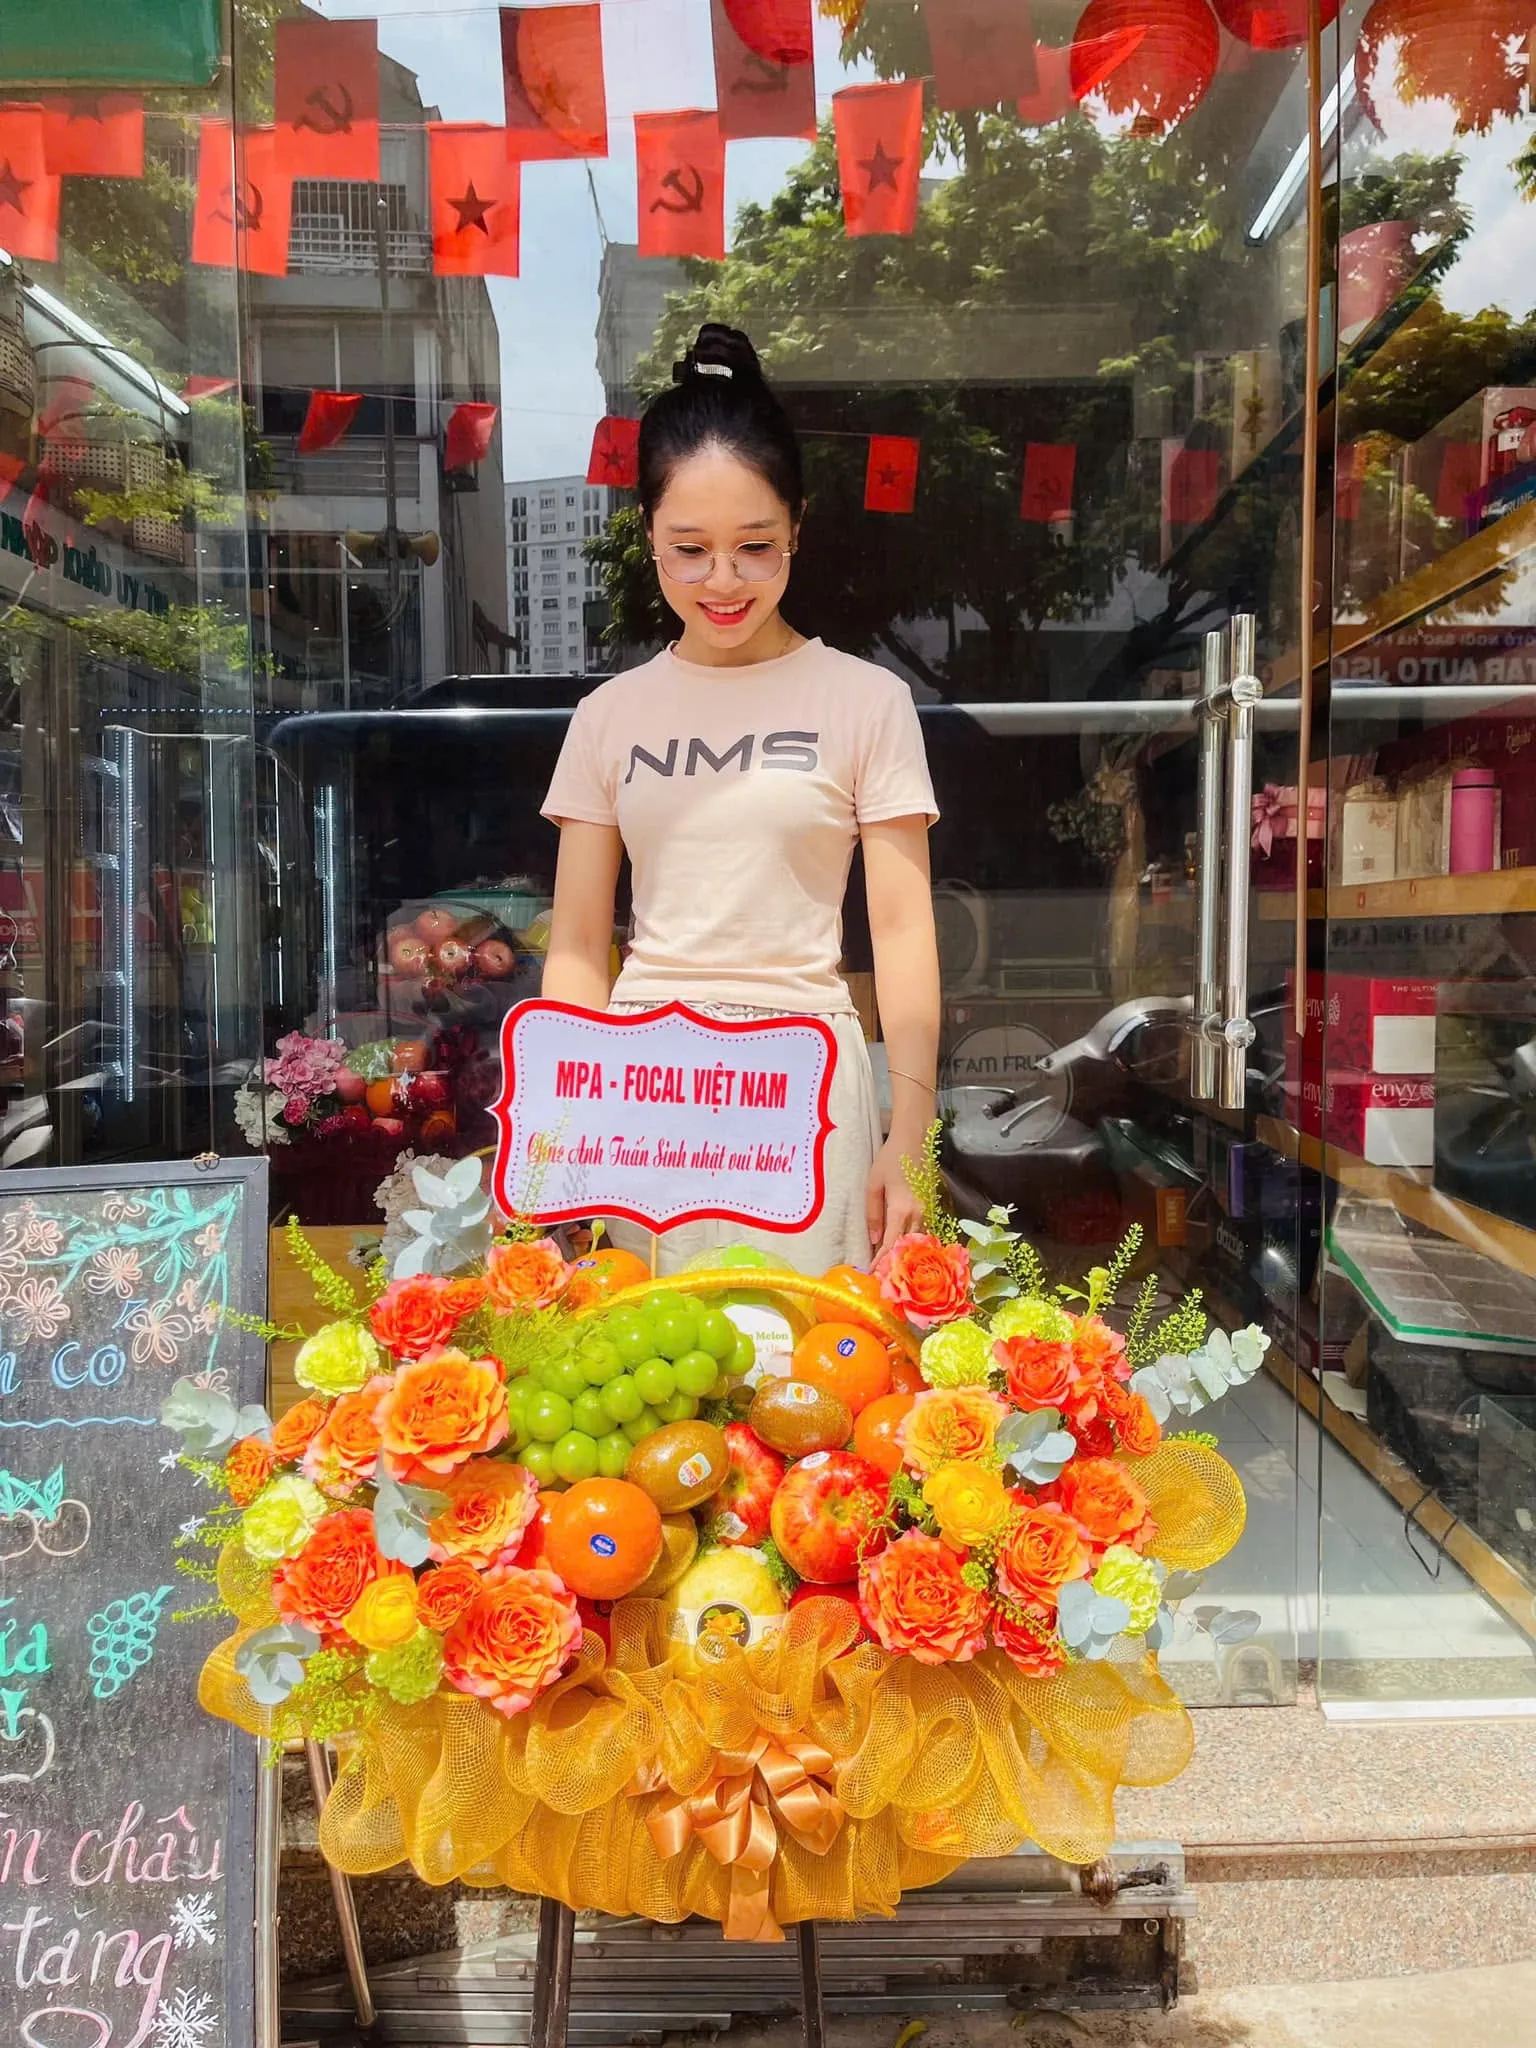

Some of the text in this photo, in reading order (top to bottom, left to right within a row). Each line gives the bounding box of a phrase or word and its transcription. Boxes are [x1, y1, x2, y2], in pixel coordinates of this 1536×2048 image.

[625, 731, 819, 784] NMS
[556, 1060, 603, 1098] MPA
[624, 1064, 686, 1104] FOCAL
[694, 1061, 736, 1114] VIỆT
[740, 1071, 788, 1110] NAM
[953, 1056, 997, 1075] FAM
[1372, 1083, 1421, 1106] envy
[568, 1134, 603, 1166] Anh
[609, 1135, 650, 1168] Tuấn
[653, 1137, 687, 1168] Sinh
[691, 1140, 727, 1177] nhật
[728, 1144, 752, 1171] vui
[756, 1331, 789, 1341] Melon
[3, 1905, 174, 2048] tặng
